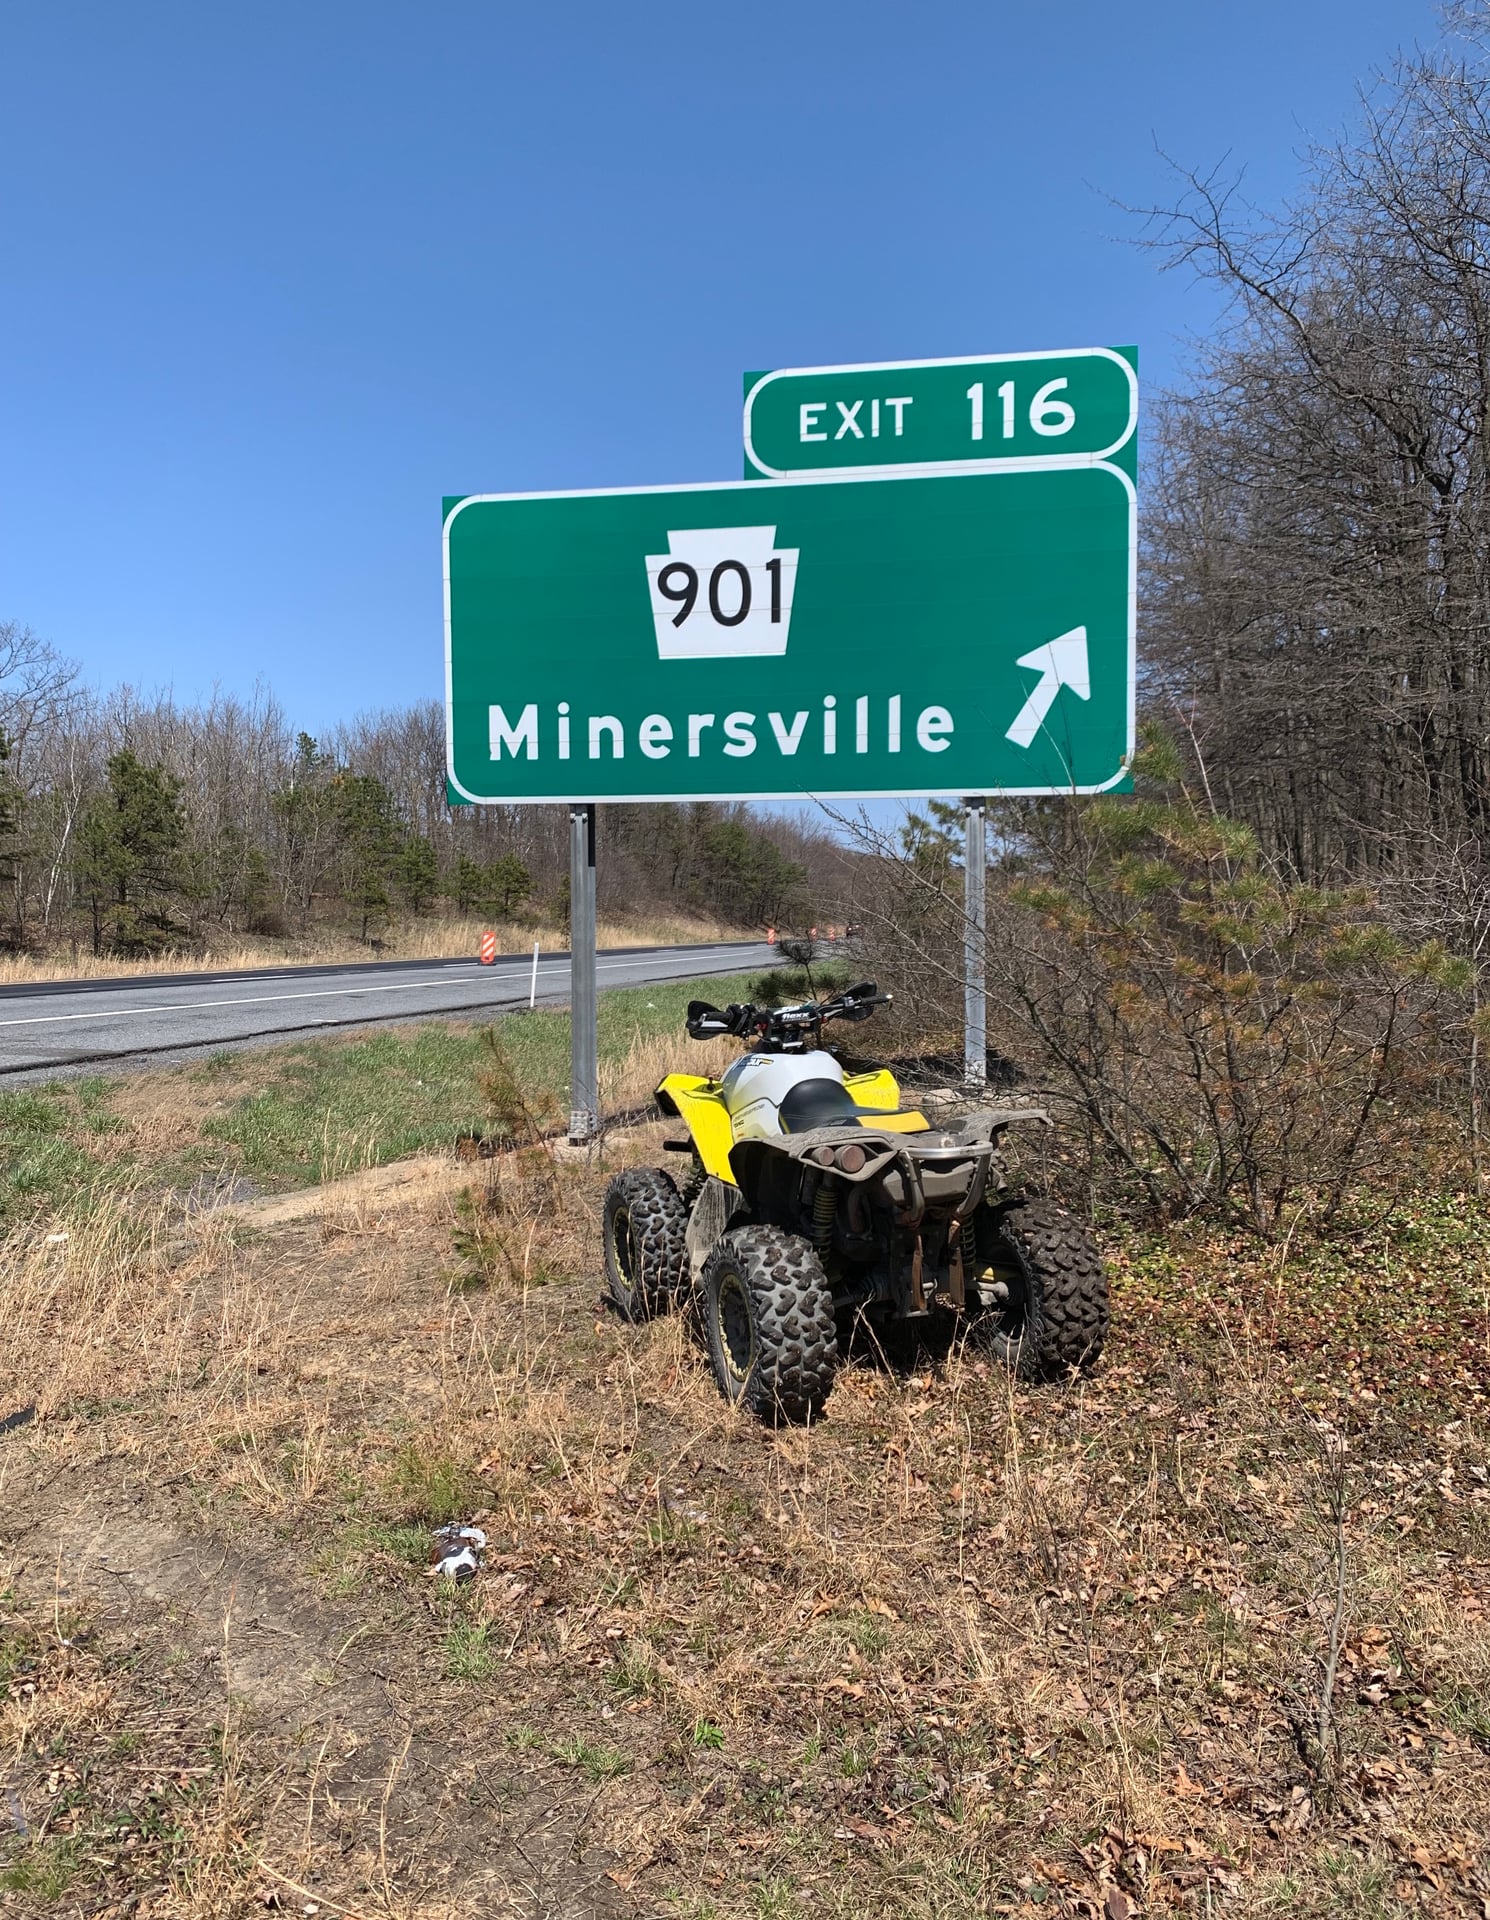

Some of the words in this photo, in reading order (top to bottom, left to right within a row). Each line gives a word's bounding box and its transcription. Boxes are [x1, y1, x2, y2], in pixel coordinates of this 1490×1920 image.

[799, 396, 913, 442] EXIT
[966, 377, 1076, 440] 116
[656, 558, 782, 628] 901
[488, 694, 954, 761] Minersville
